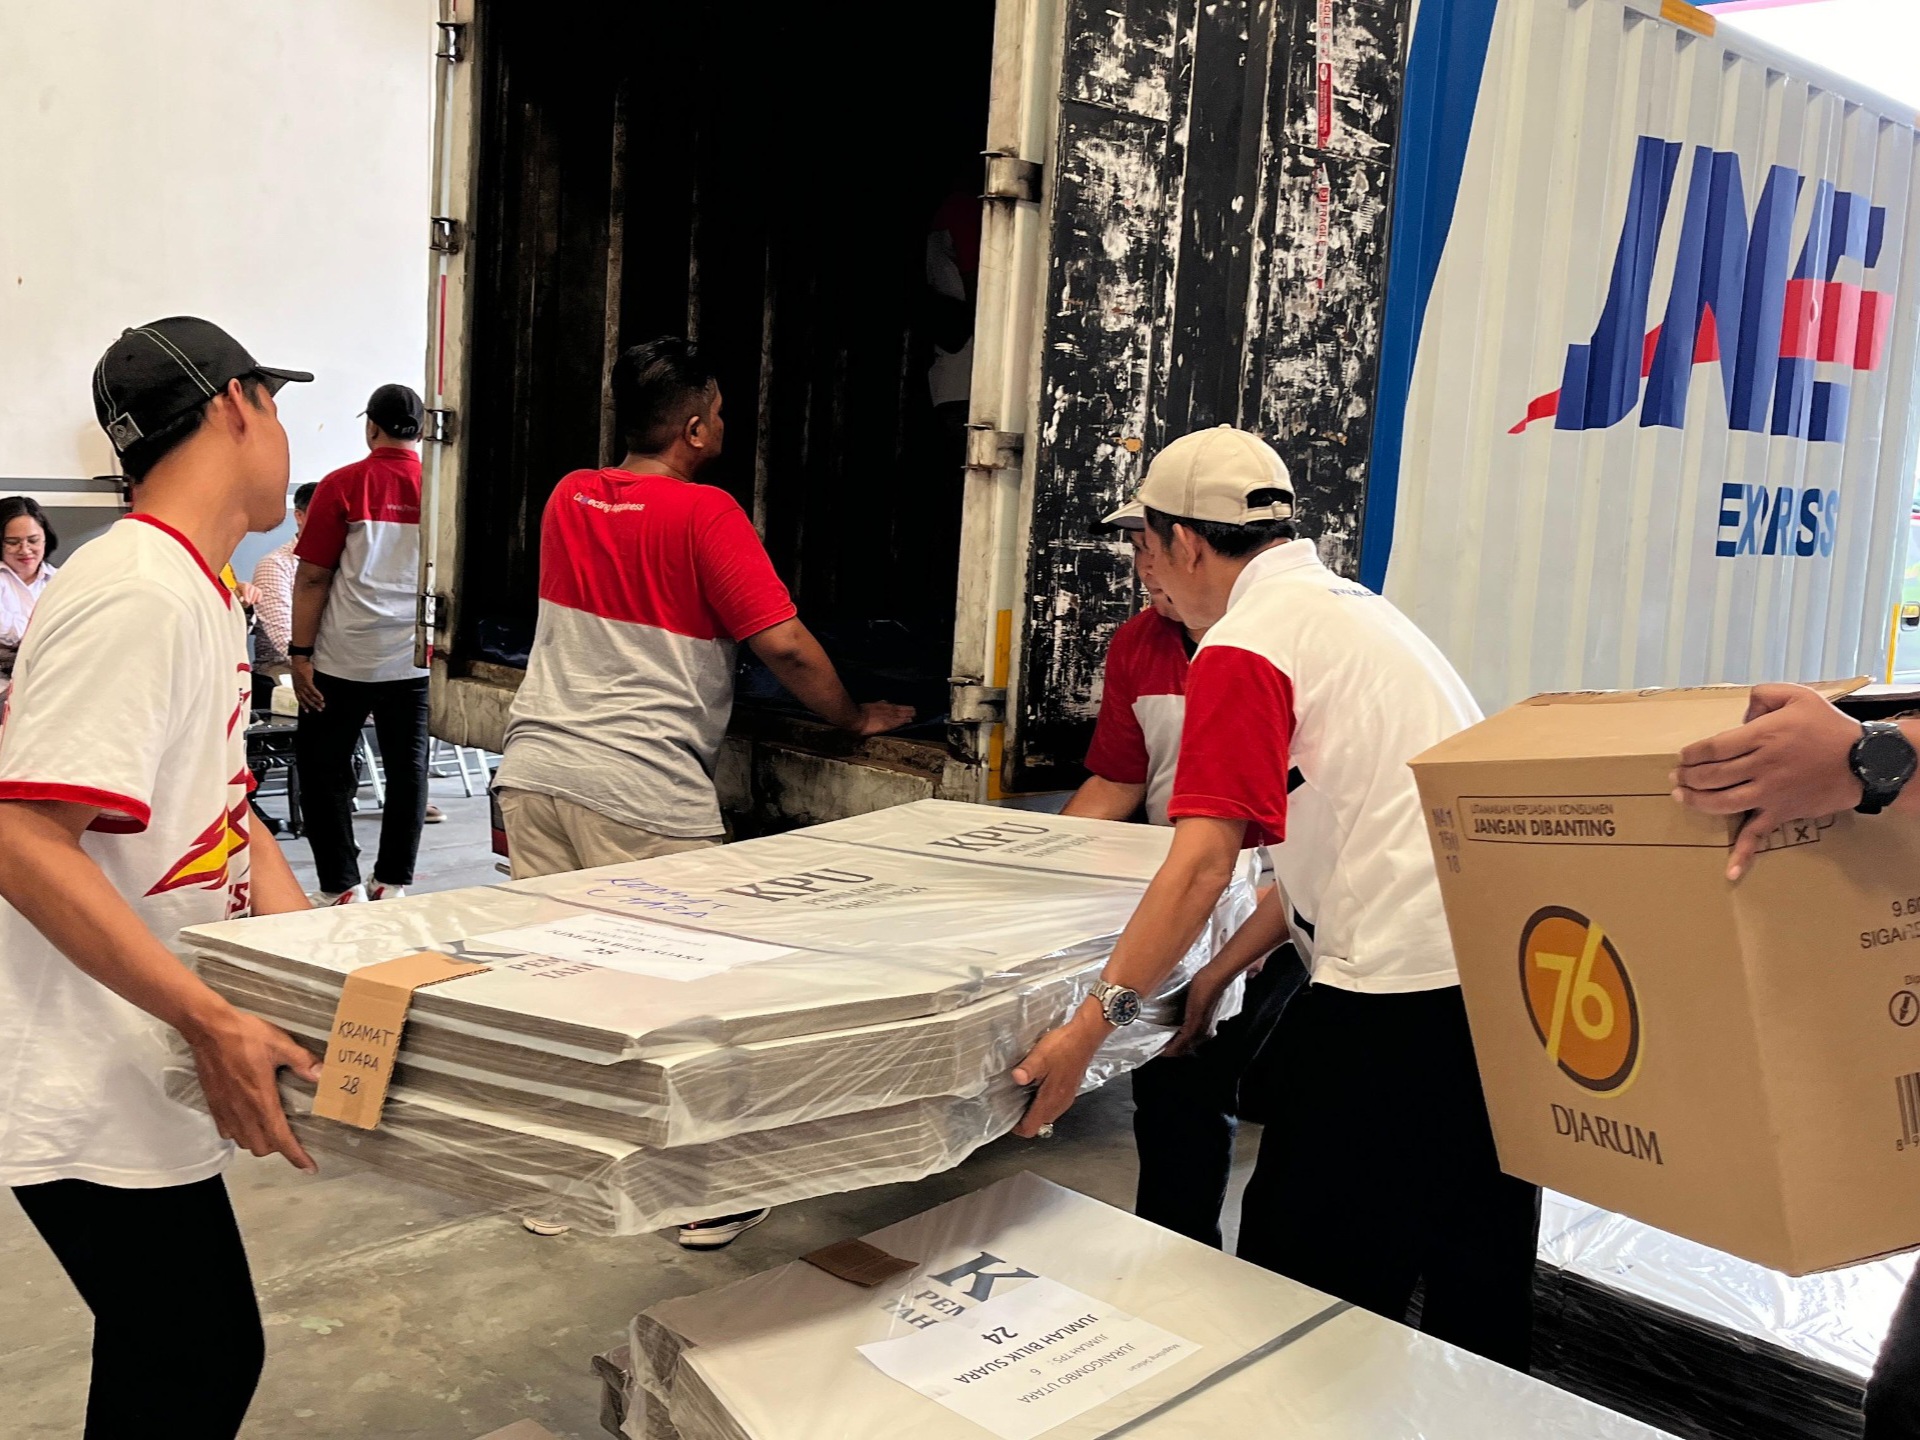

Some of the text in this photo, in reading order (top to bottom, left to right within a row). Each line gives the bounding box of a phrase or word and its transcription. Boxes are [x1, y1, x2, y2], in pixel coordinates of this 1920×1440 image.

[1318, 204, 1328, 246] FRAGILE
[1553, 134, 1894, 443] JNE
[1715, 482, 1840, 558] EXRSS
[1558, 803, 1614, 816] KONSUMEN
[925, 820, 1051, 852] KPU
[1474, 818, 1616, 837] JANGAN DIBANTING
[715, 867, 874, 903] KPU
[1534, 920, 1616, 1067] 76
[338, 1020, 395, 1047] KRAMAT
[338, 1049, 379, 1071] UTARA
[339, 1074, 360, 1095] 28
[1550, 1103, 1664, 1166] DJARUM
[953, 1313, 1099, 1385] JUMLAH BILIK SUARA
[981, 1326, 1019, 1345] 24
[1070, 1333, 1109, 1356] JUMLAH
[1017, 1342, 1136, 1404] JURANGOMBO UTARA
[1030, 1367, 1042, 1376] 6
